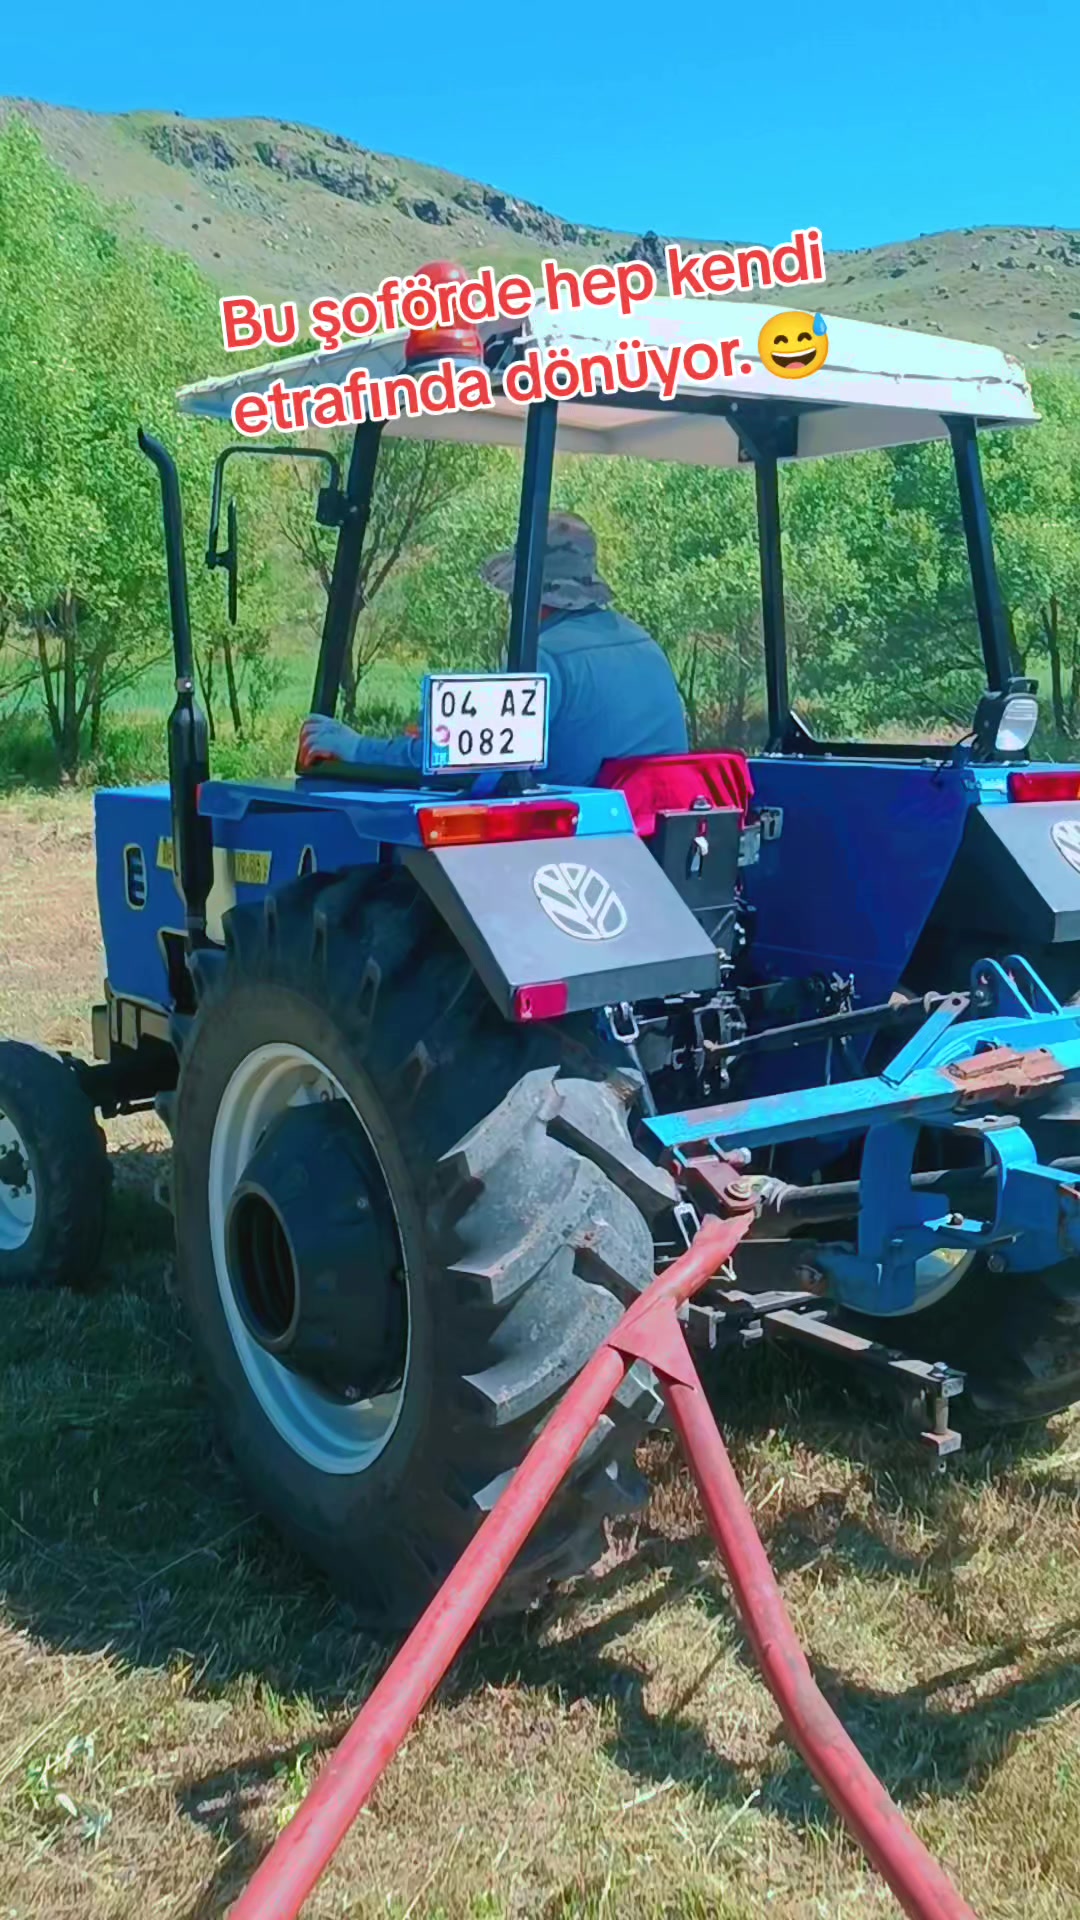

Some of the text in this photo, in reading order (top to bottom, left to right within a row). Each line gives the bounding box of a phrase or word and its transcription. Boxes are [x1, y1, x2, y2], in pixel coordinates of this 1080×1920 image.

[440, 689, 537, 718] 04 AZ
[457, 727, 514, 756] 082
